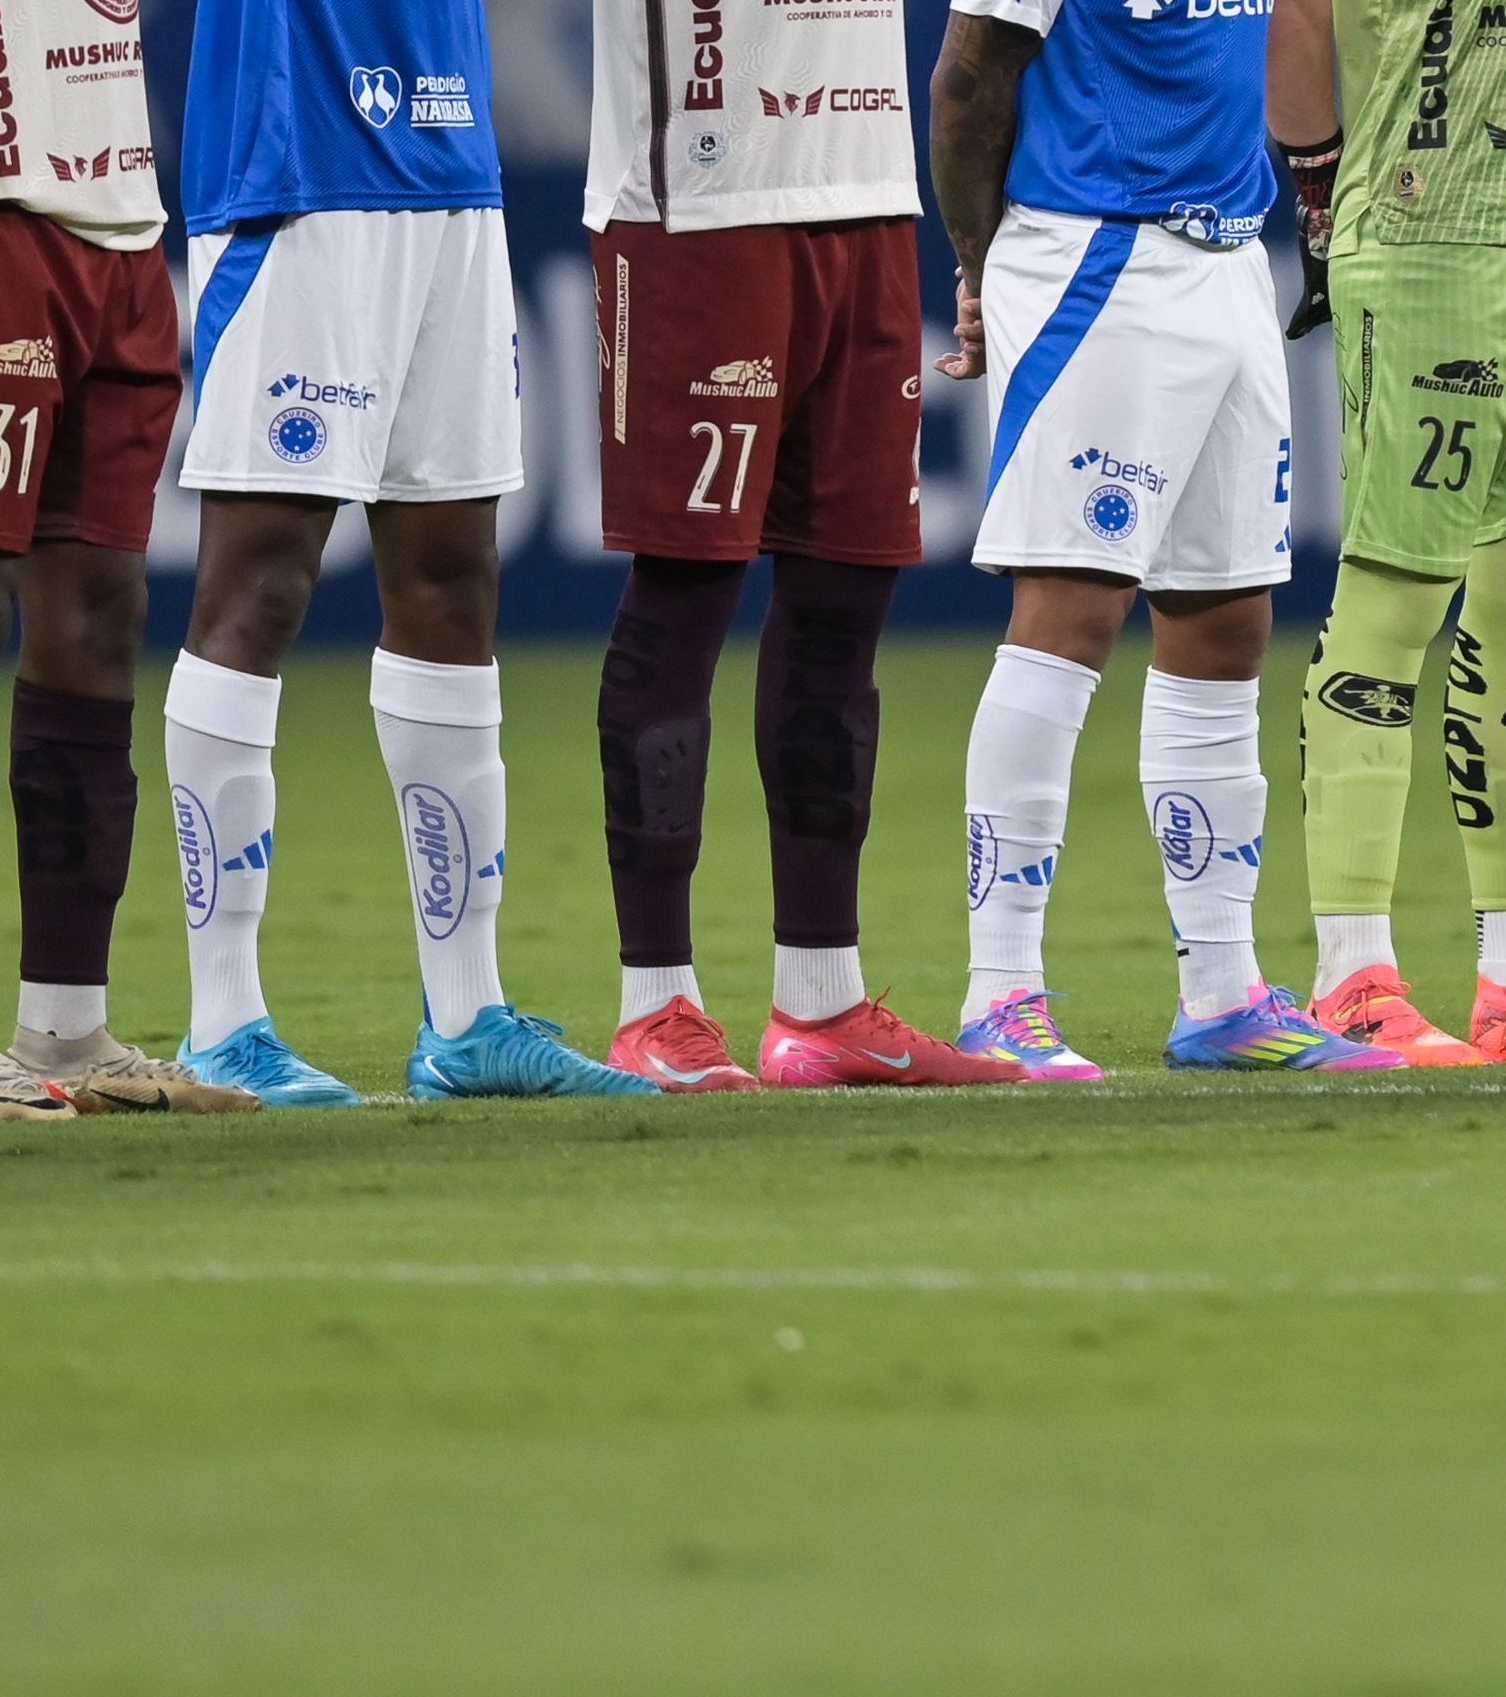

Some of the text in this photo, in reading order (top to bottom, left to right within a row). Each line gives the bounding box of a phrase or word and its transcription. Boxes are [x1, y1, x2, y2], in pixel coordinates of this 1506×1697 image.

[45, 42, 130, 70] MUSHUC
[616, 262, 628, 425] NEGOCIOS INMOBILIARIOS
[1362, 316, 1373, 404] INMOBILIARIOS
[689, 379, 779, 398] MushucAuto
[1411, 373, 1504, 399] MushucAuto
[277, 409, 322, 428] CRUZEIRO
[270, 429, 325, 462] ESPORTE CLUBE
[1410, 415, 1476, 492] 25
[686, 420, 758, 514] 27
[1101, 450, 1170, 497] betfair
[1092, 486, 1134, 506] CRUZEIRO
[1086, 507, 1137, 539] ESPORTE CLUBE
[170, 790, 207, 909] Kodilar
[410, 792, 454, 919] Kodilar
